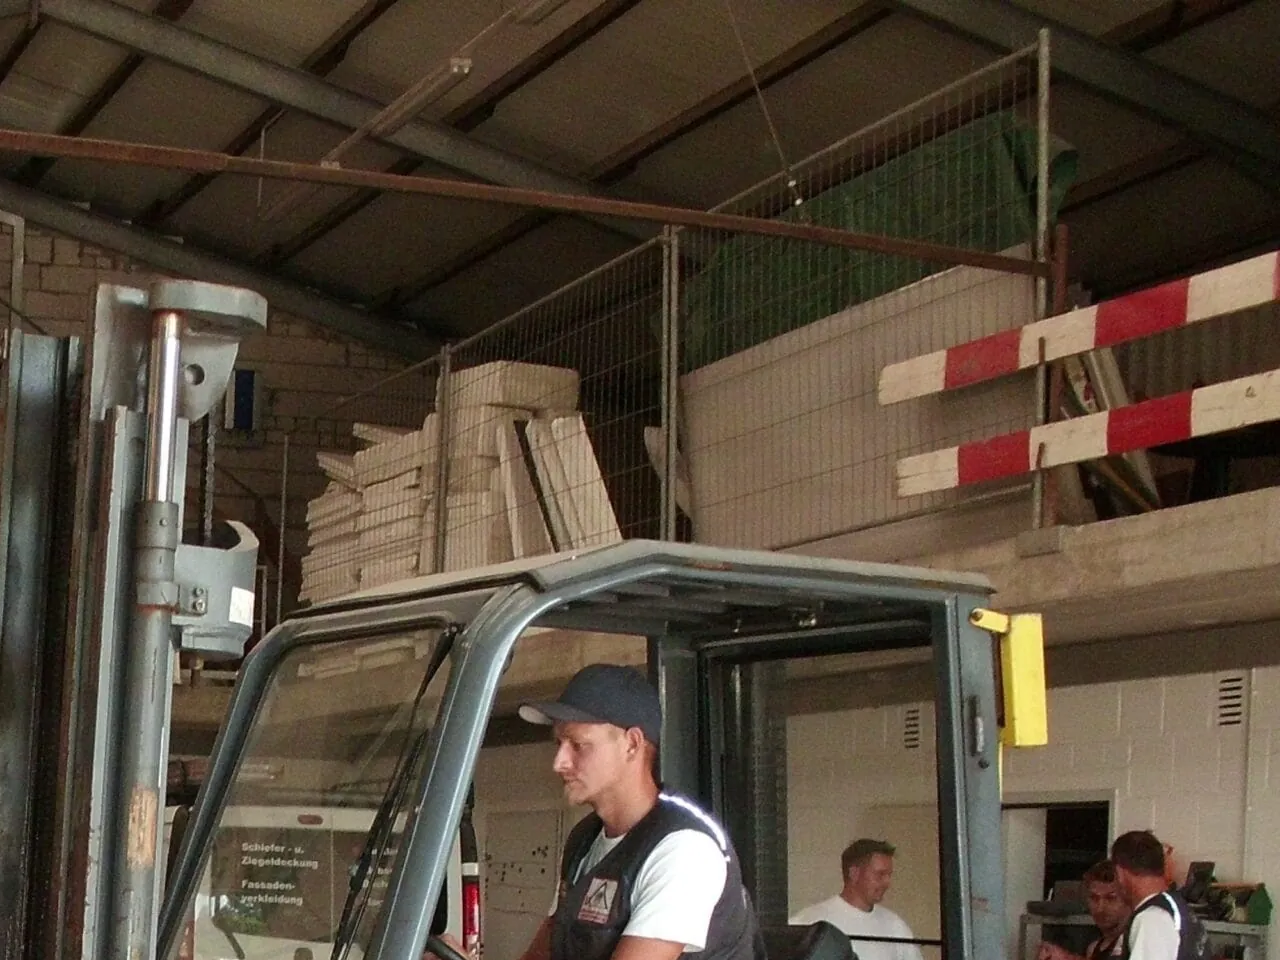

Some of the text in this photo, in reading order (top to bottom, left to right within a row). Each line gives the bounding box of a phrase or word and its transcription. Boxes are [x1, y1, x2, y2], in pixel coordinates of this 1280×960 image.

[241, 843, 286, 853] Schiefer
[241, 856, 319, 869] Ziegeldeckung
[241, 879, 296, 890] Fassaden-
[240, 894, 304, 906] verkleidung
